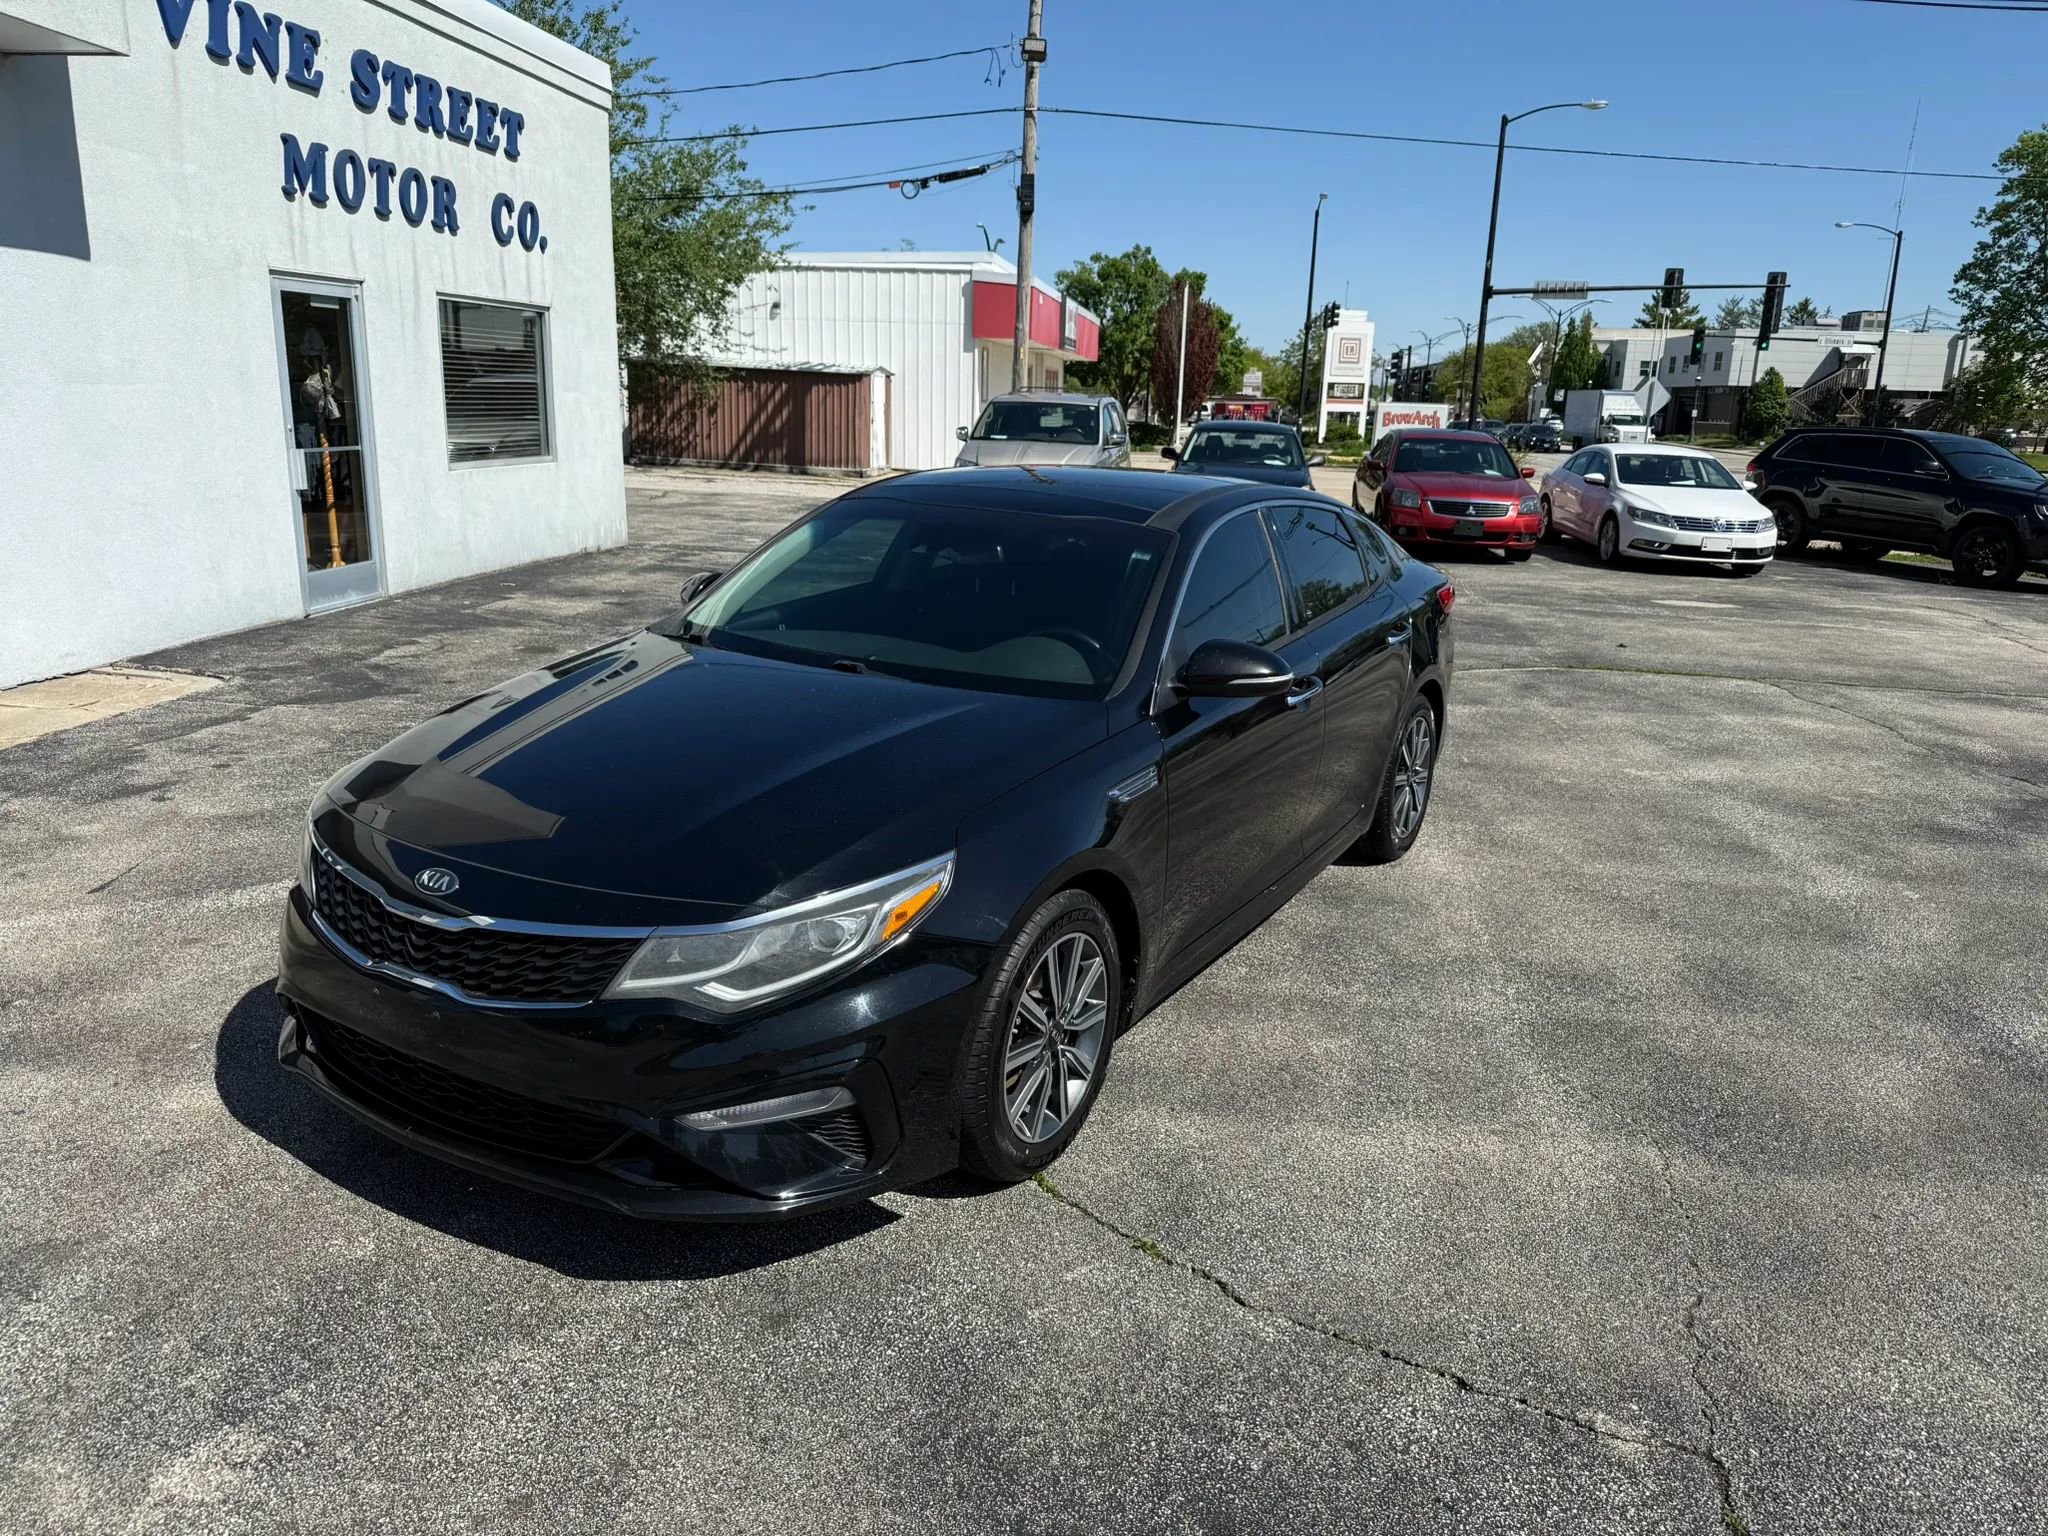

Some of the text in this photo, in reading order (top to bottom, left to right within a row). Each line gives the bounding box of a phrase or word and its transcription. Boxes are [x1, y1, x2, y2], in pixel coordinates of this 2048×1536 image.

[156, 0, 524, 161] VINE STREET
[280, 133, 548, 254] MOTOR CO.
[1382, 410, 1441, 428] BrowArch
[419, 870, 450, 891] KIA
